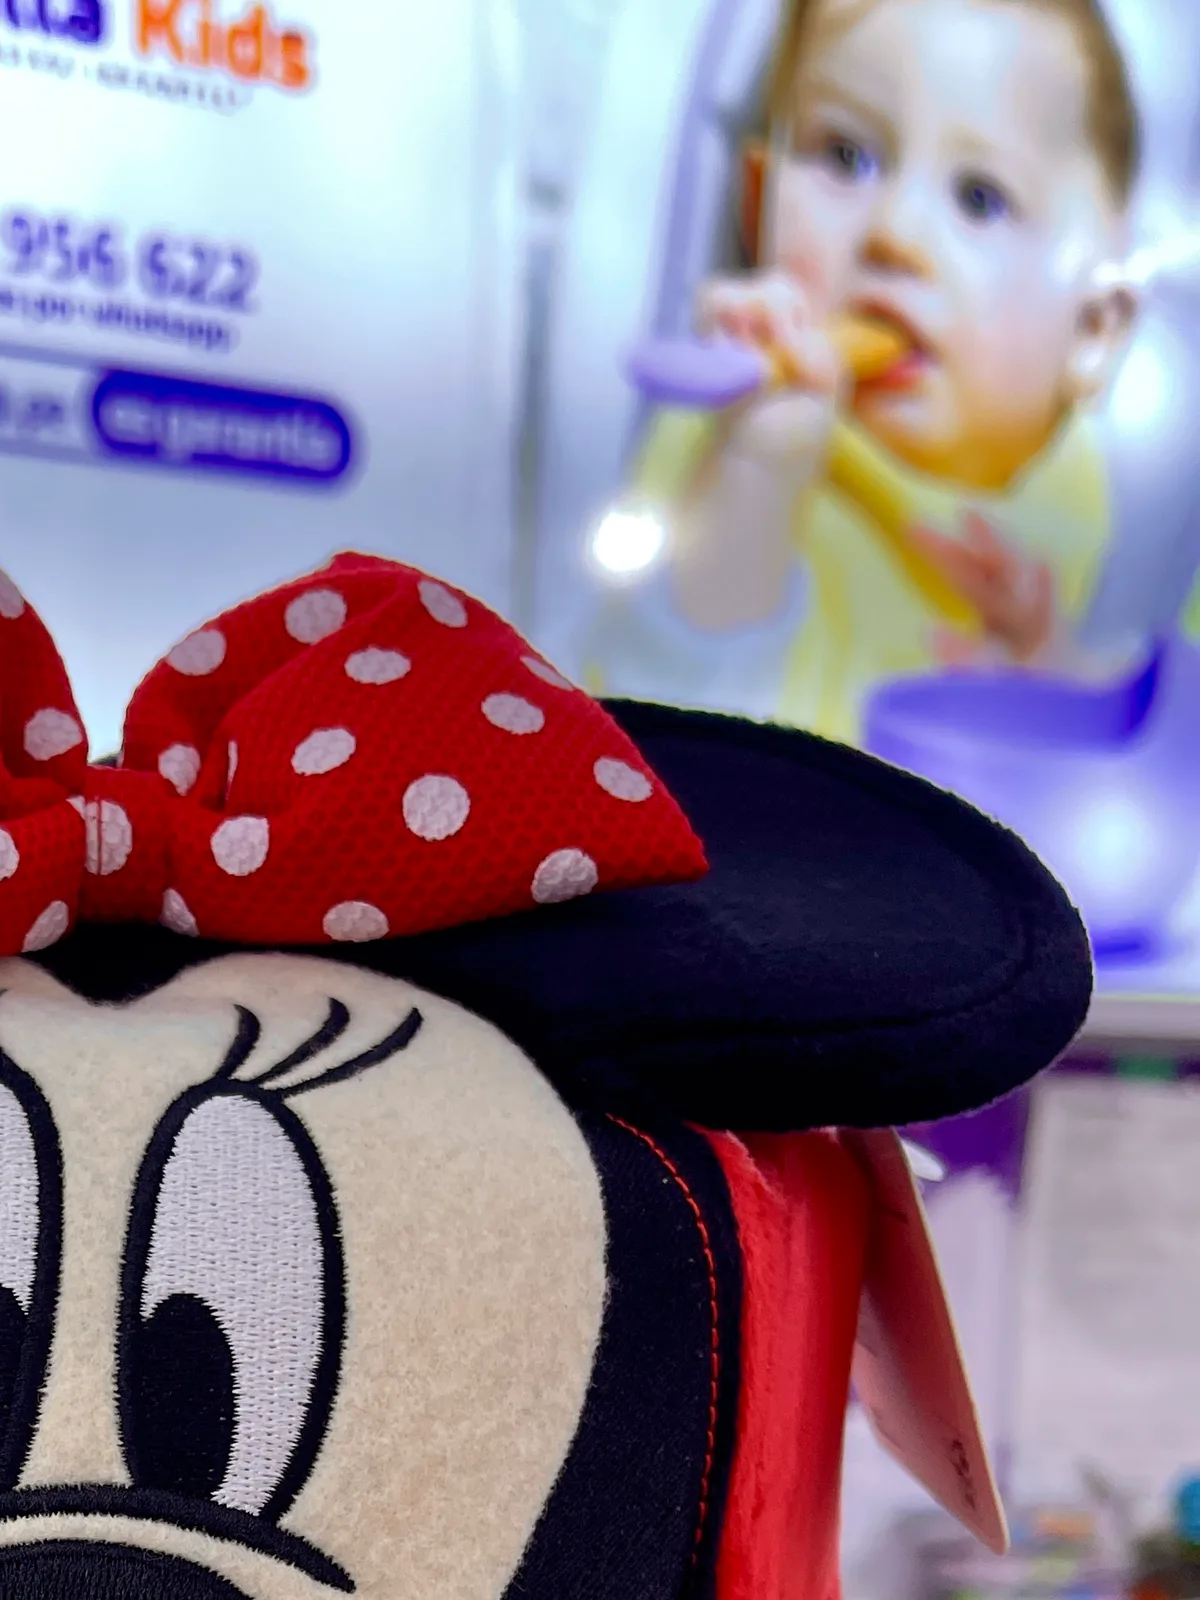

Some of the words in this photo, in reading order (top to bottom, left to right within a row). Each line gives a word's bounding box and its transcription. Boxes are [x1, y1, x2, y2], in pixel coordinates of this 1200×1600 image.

[135, 0, 308, 89] Kids
[1, 209, 127, 292] 956
[137, 230, 260, 314] 622
